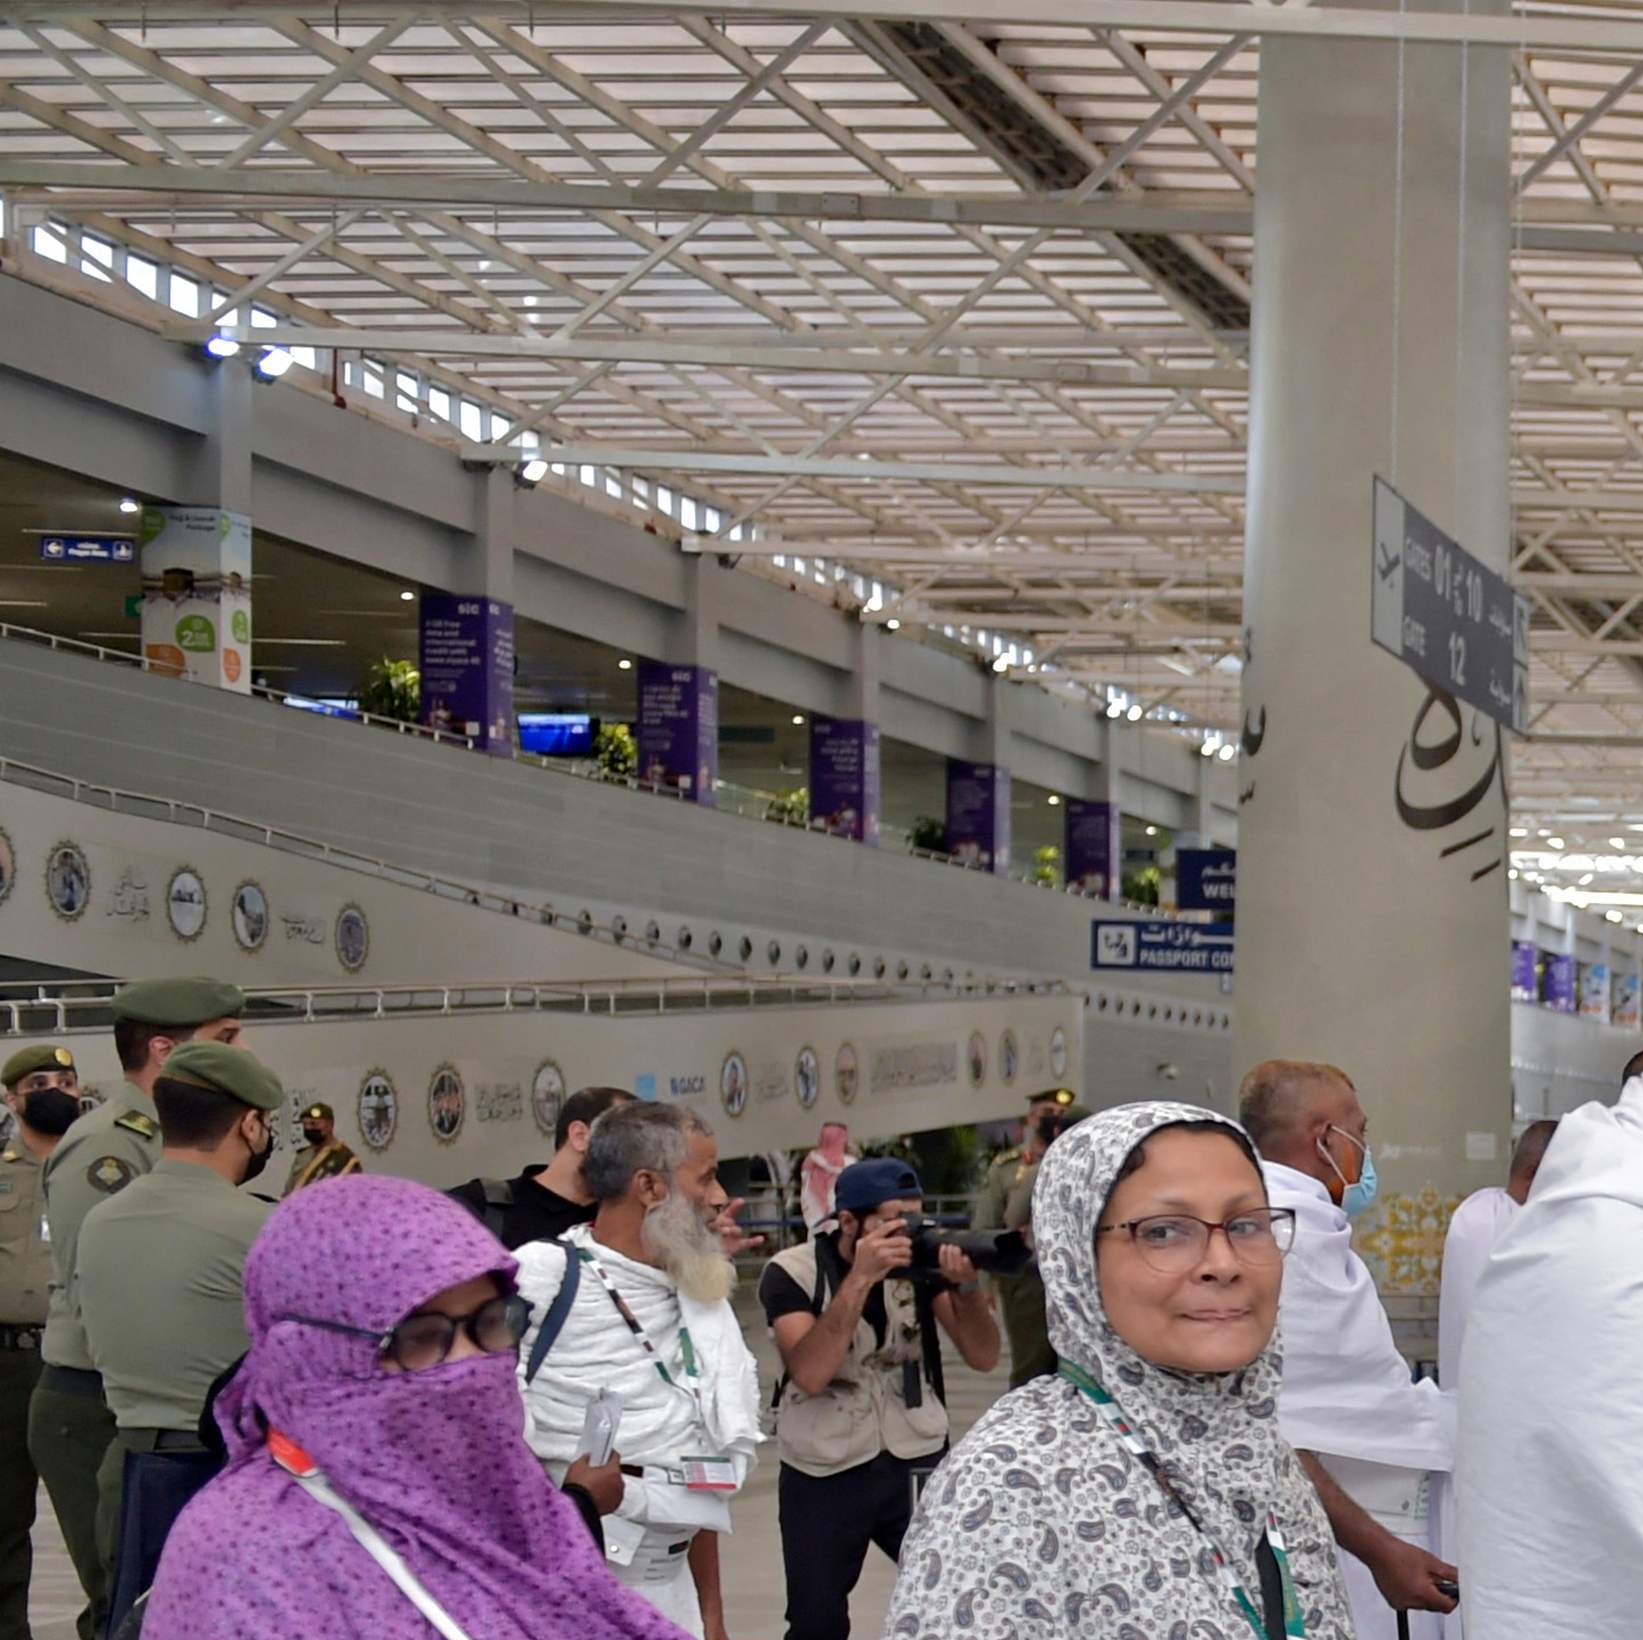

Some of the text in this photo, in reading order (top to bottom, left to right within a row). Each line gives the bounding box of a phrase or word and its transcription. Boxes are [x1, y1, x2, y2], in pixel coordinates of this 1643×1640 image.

[1466, 568, 1484, 623] 10
[1449, 630, 1467, 688] 12
[1139, 948, 1208, 968] PASSPORT
